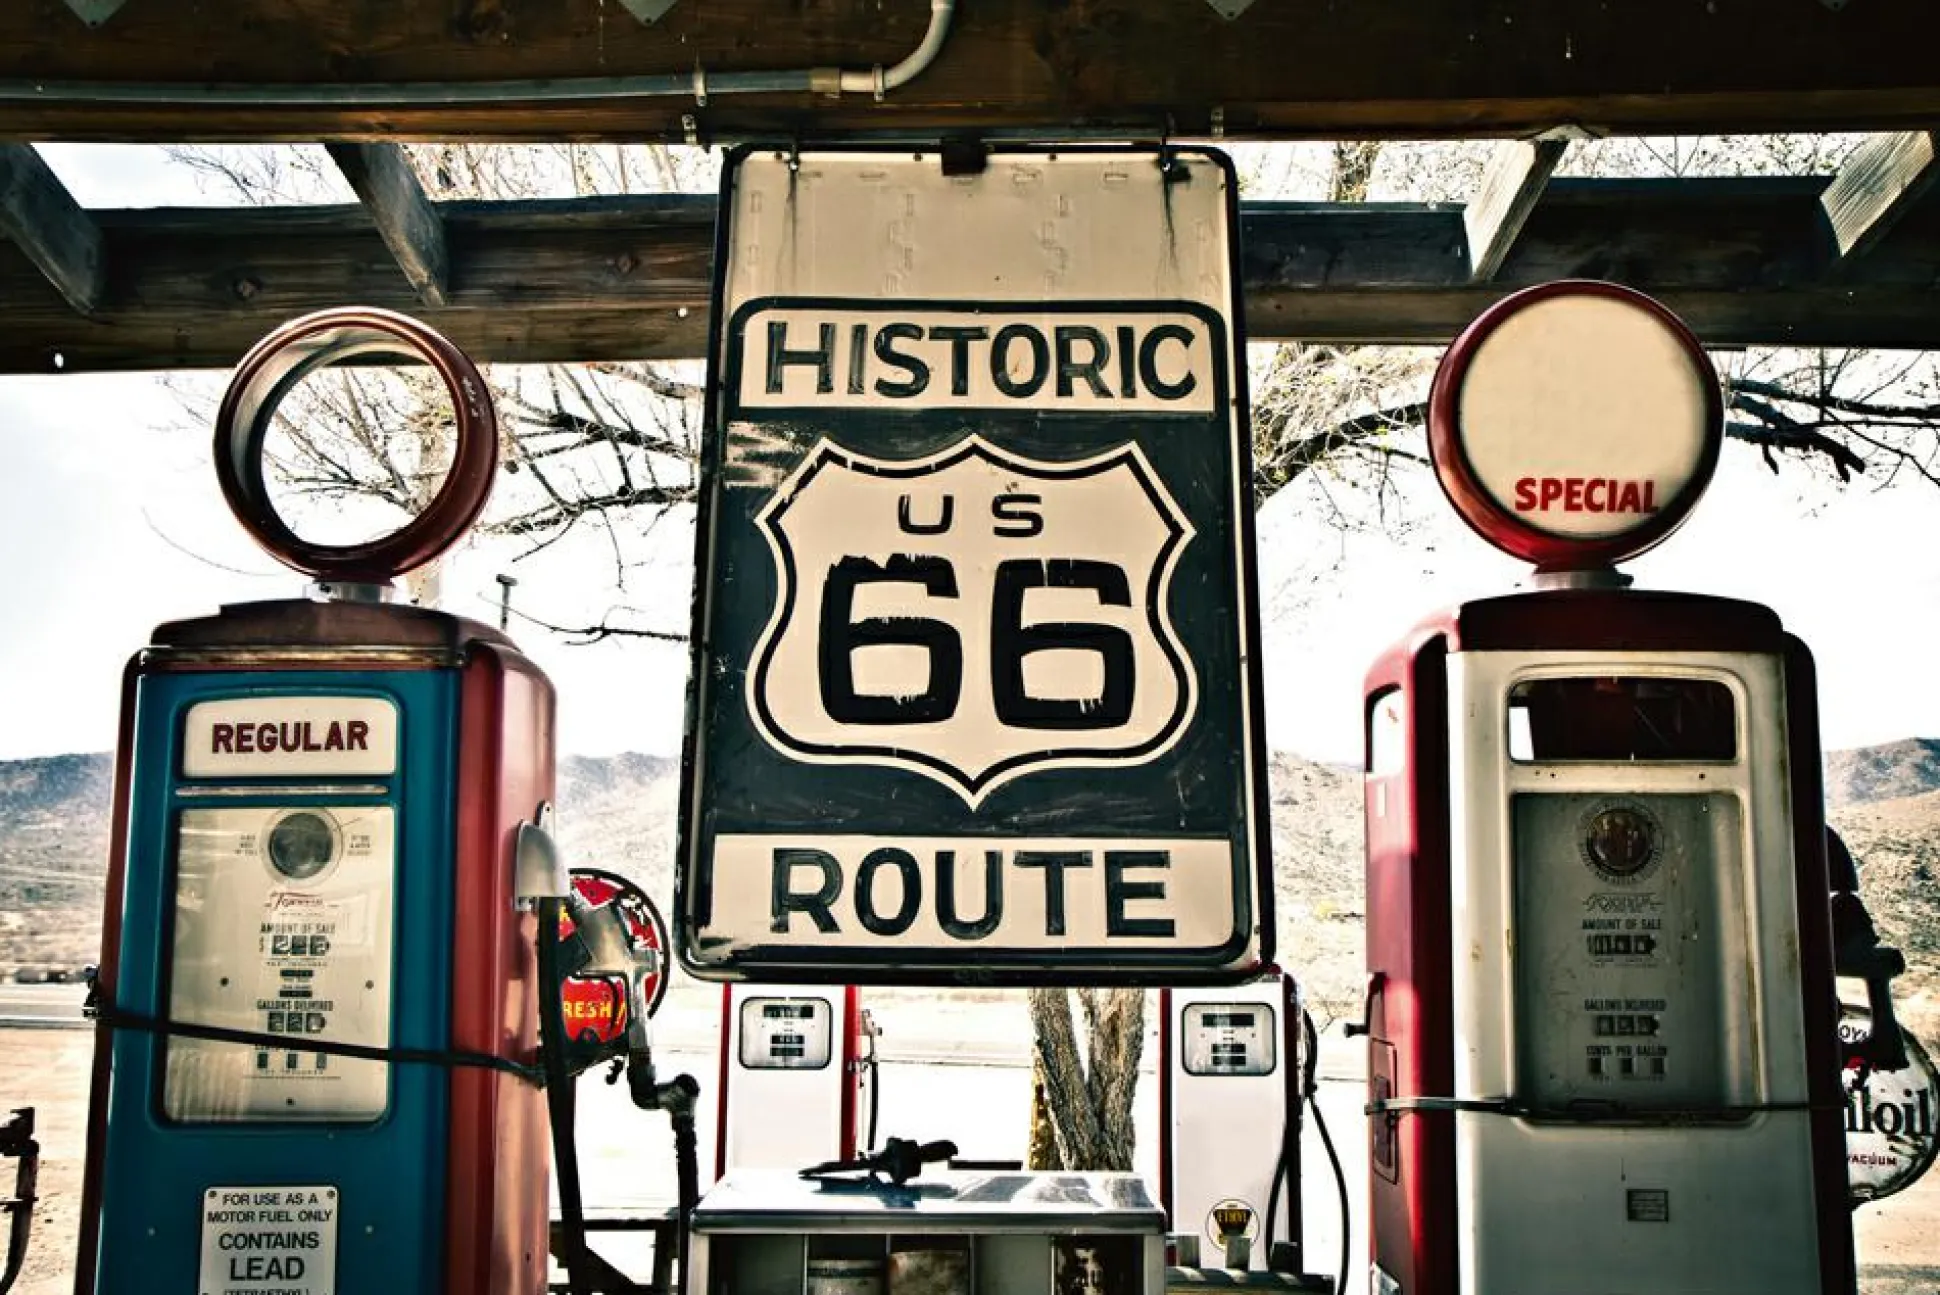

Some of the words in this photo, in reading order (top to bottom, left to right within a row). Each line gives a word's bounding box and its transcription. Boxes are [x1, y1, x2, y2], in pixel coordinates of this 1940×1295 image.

[766, 321, 1197, 400] HISTORIC
[1514, 477, 1659, 514] SPECIAL
[898, 495, 954, 535] U
[991, 494, 1044, 538] S
[818, 553, 1135, 731] 66
[212, 721, 369, 754] REGULAR
[770, 848, 1176, 940] ROUTE
[260, 923, 297, 934] AMOUNT
[1582, 918, 1620, 930] AMOUNT
[222, 1192, 250, 1205] FOR
[254, 1192, 281, 1205] USE
[285, 1192, 304, 1205] AS
[308, 1192, 319, 1204] A
[207, 1210, 256, 1223] MOTOR
[258, 1209, 294, 1222] FUEL
[297, 1208, 332, 1222] ONLY
[219, 1231, 320, 1250] CONTAINS
[230, 1256, 305, 1281] LEAD
